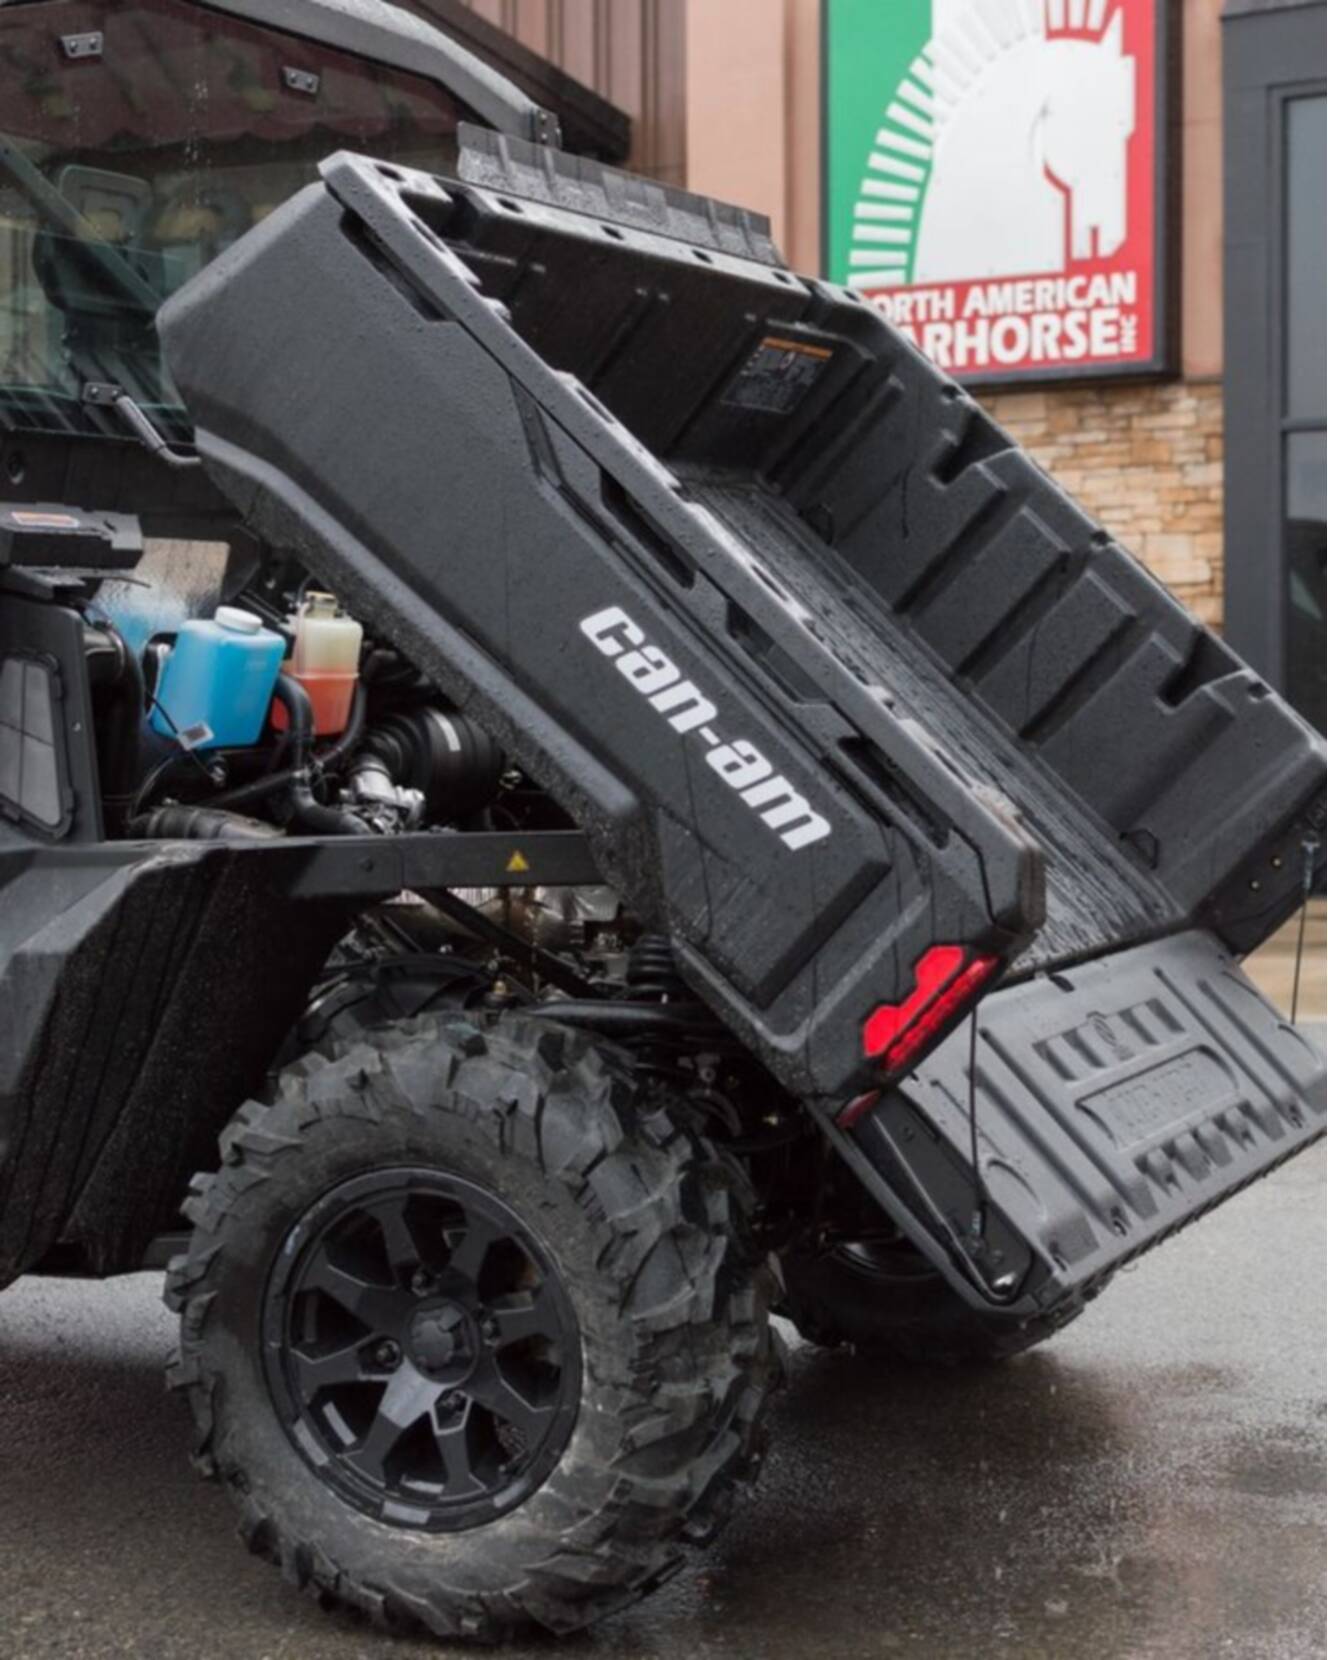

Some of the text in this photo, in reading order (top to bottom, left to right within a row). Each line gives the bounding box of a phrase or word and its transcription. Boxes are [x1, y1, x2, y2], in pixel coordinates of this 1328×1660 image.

[863, 270, 1137, 325] ORTH AMERICAN
[580, 606, 831, 851] can-am
